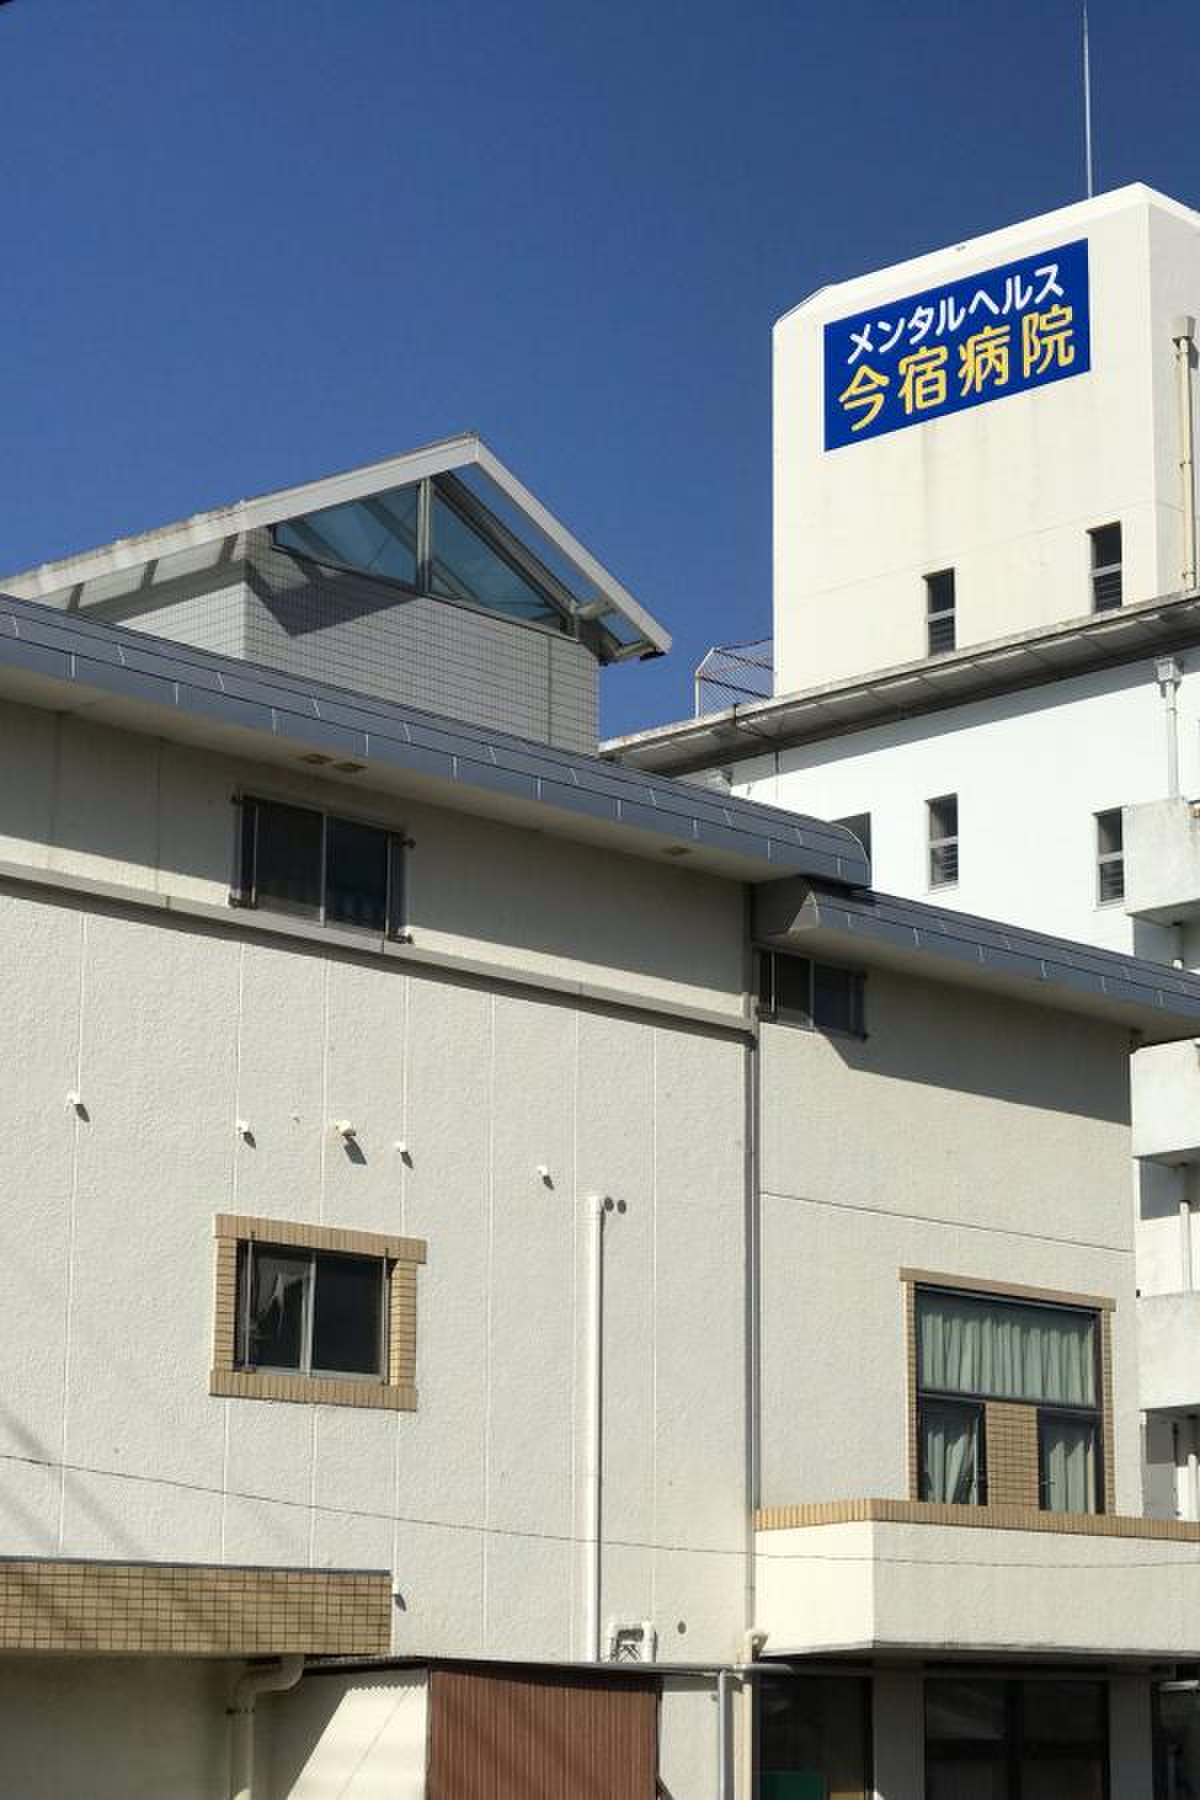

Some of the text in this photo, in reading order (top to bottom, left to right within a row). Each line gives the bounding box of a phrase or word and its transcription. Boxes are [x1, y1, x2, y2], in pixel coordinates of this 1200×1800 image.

[838, 303, 1076, 432] 今宿病院
[847, 263, 1065, 365] メンタルヘルス
